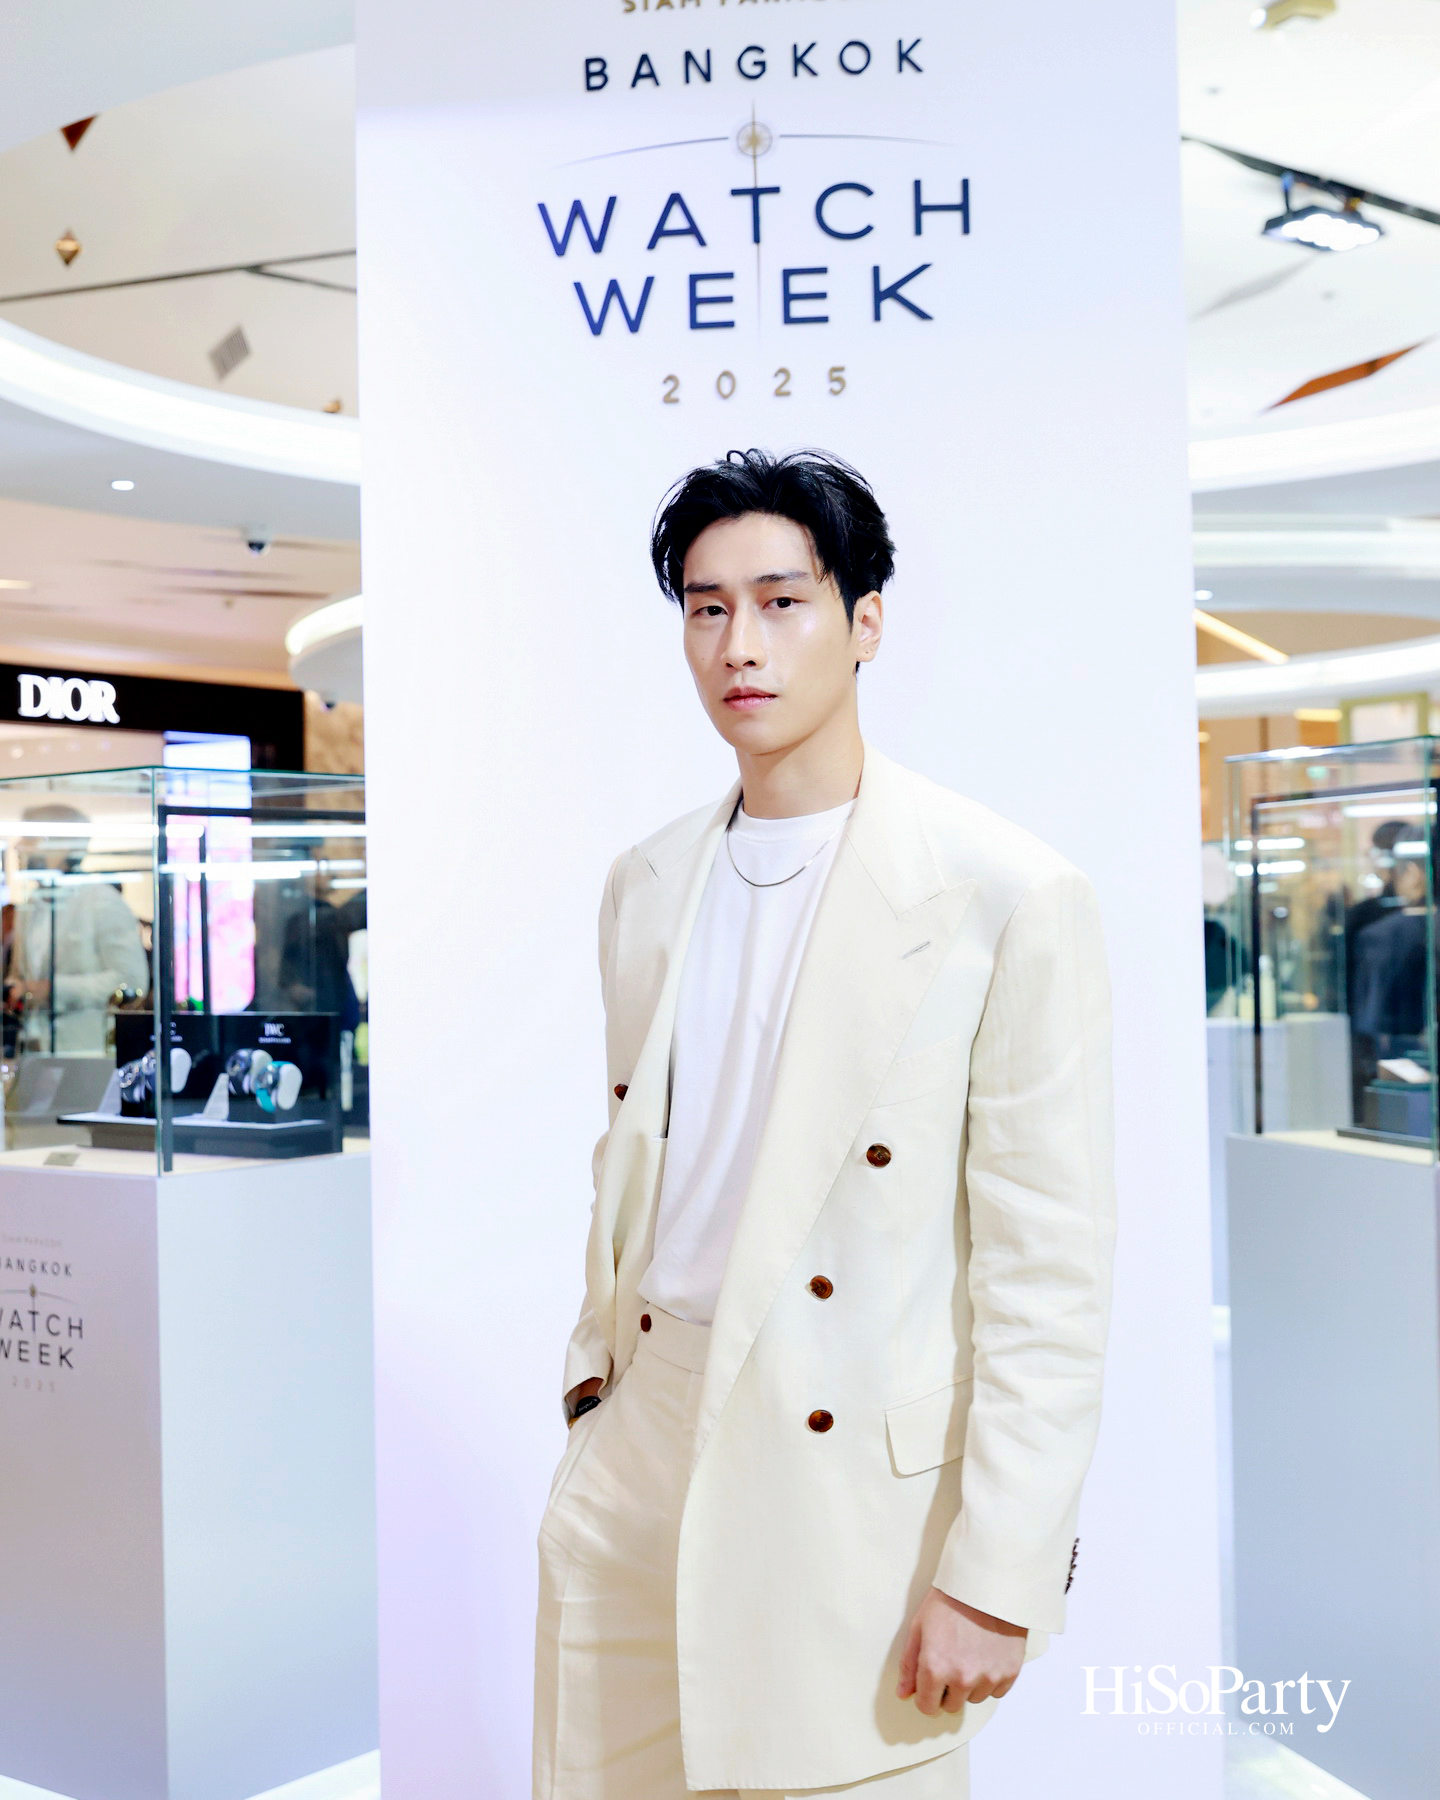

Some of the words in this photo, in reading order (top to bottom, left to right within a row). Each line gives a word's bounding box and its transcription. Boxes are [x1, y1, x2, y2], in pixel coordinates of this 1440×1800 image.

[584, 38, 923, 92] BANGKOK
[537, 178, 970, 258] WATCH
[573, 263, 934, 336] WEEK
[662, 366, 847, 404] 2025
[17, 673, 121, 725] DIOR
[0, 1256, 72, 1277] ANGKOK
[0, 1308, 83, 1339] ATCH
